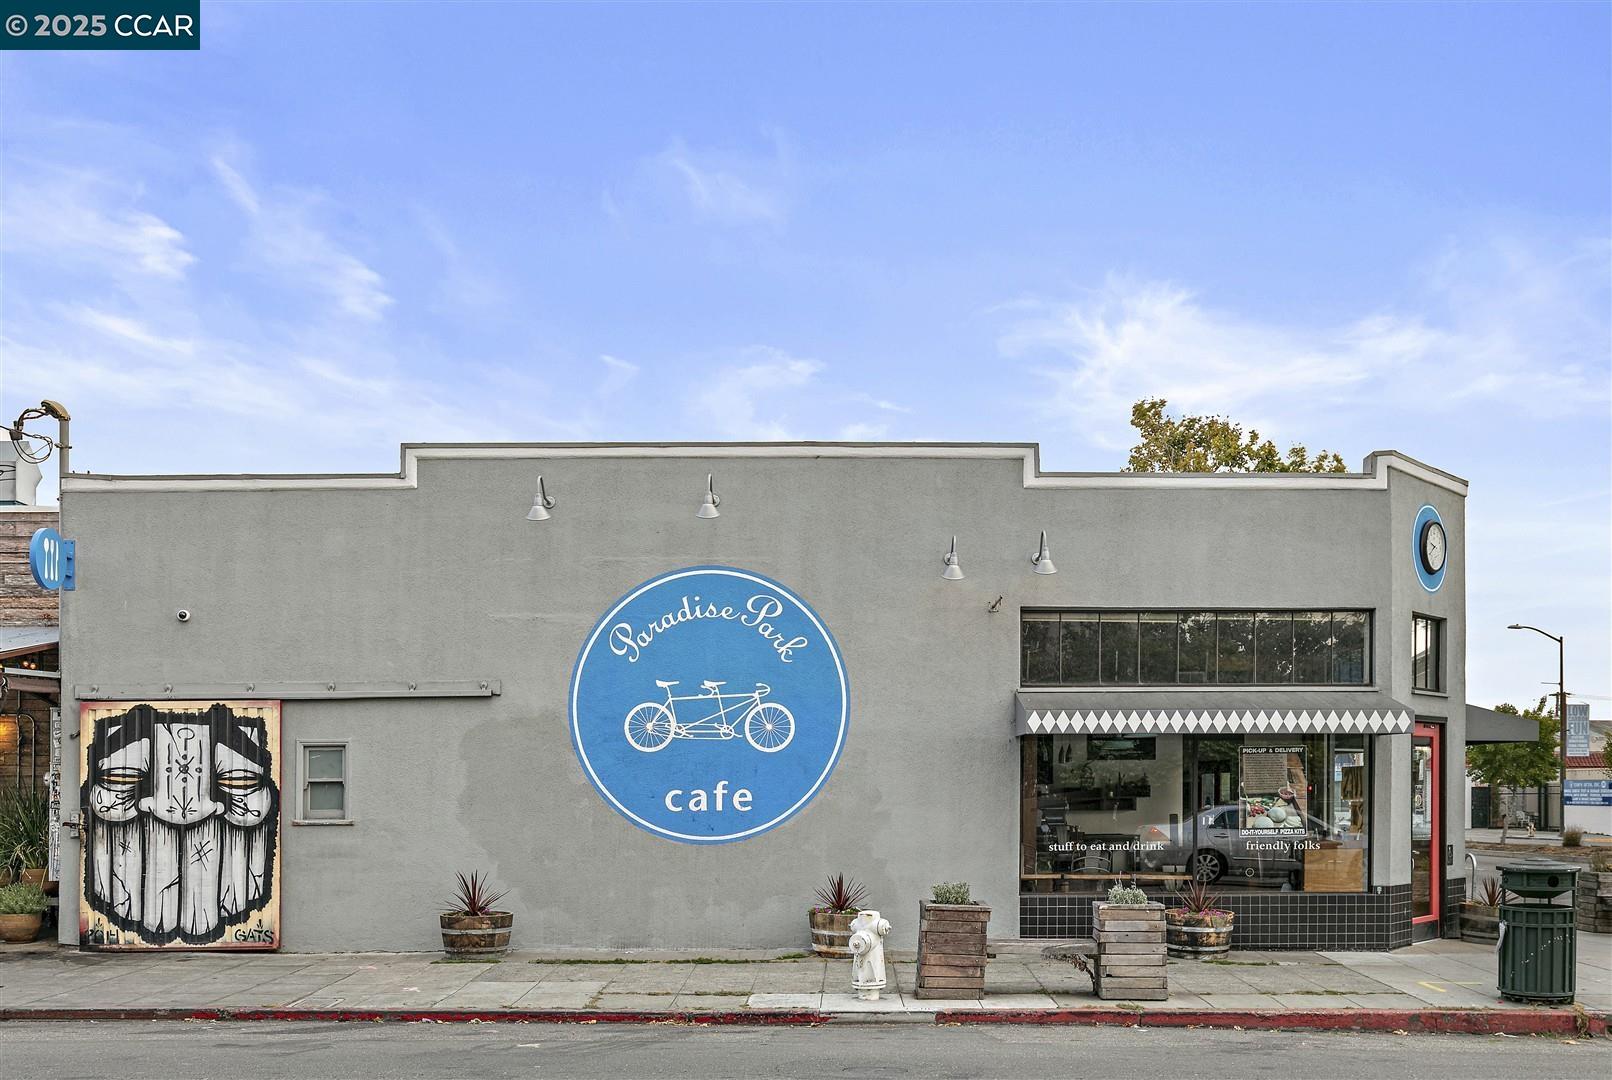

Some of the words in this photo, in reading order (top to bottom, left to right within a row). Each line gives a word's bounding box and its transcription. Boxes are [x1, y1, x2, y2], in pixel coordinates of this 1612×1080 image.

[609, 595, 741, 663] Paradise
[740, 594, 808, 663] Park
[664, 780, 753, 812] cafe
[1048, 841, 1075, 852] stuff
[1076, 843, 1087, 851] to
[1090, 843, 1106, 851] eat
[1109, 841, 1130, 851] and
[1133, 841, 1165, 851] drink
[1246, 841, 1291, 853] friendly
[1294, 841, 1321, 850] folks
[234, 928, 275, 945] GATS
